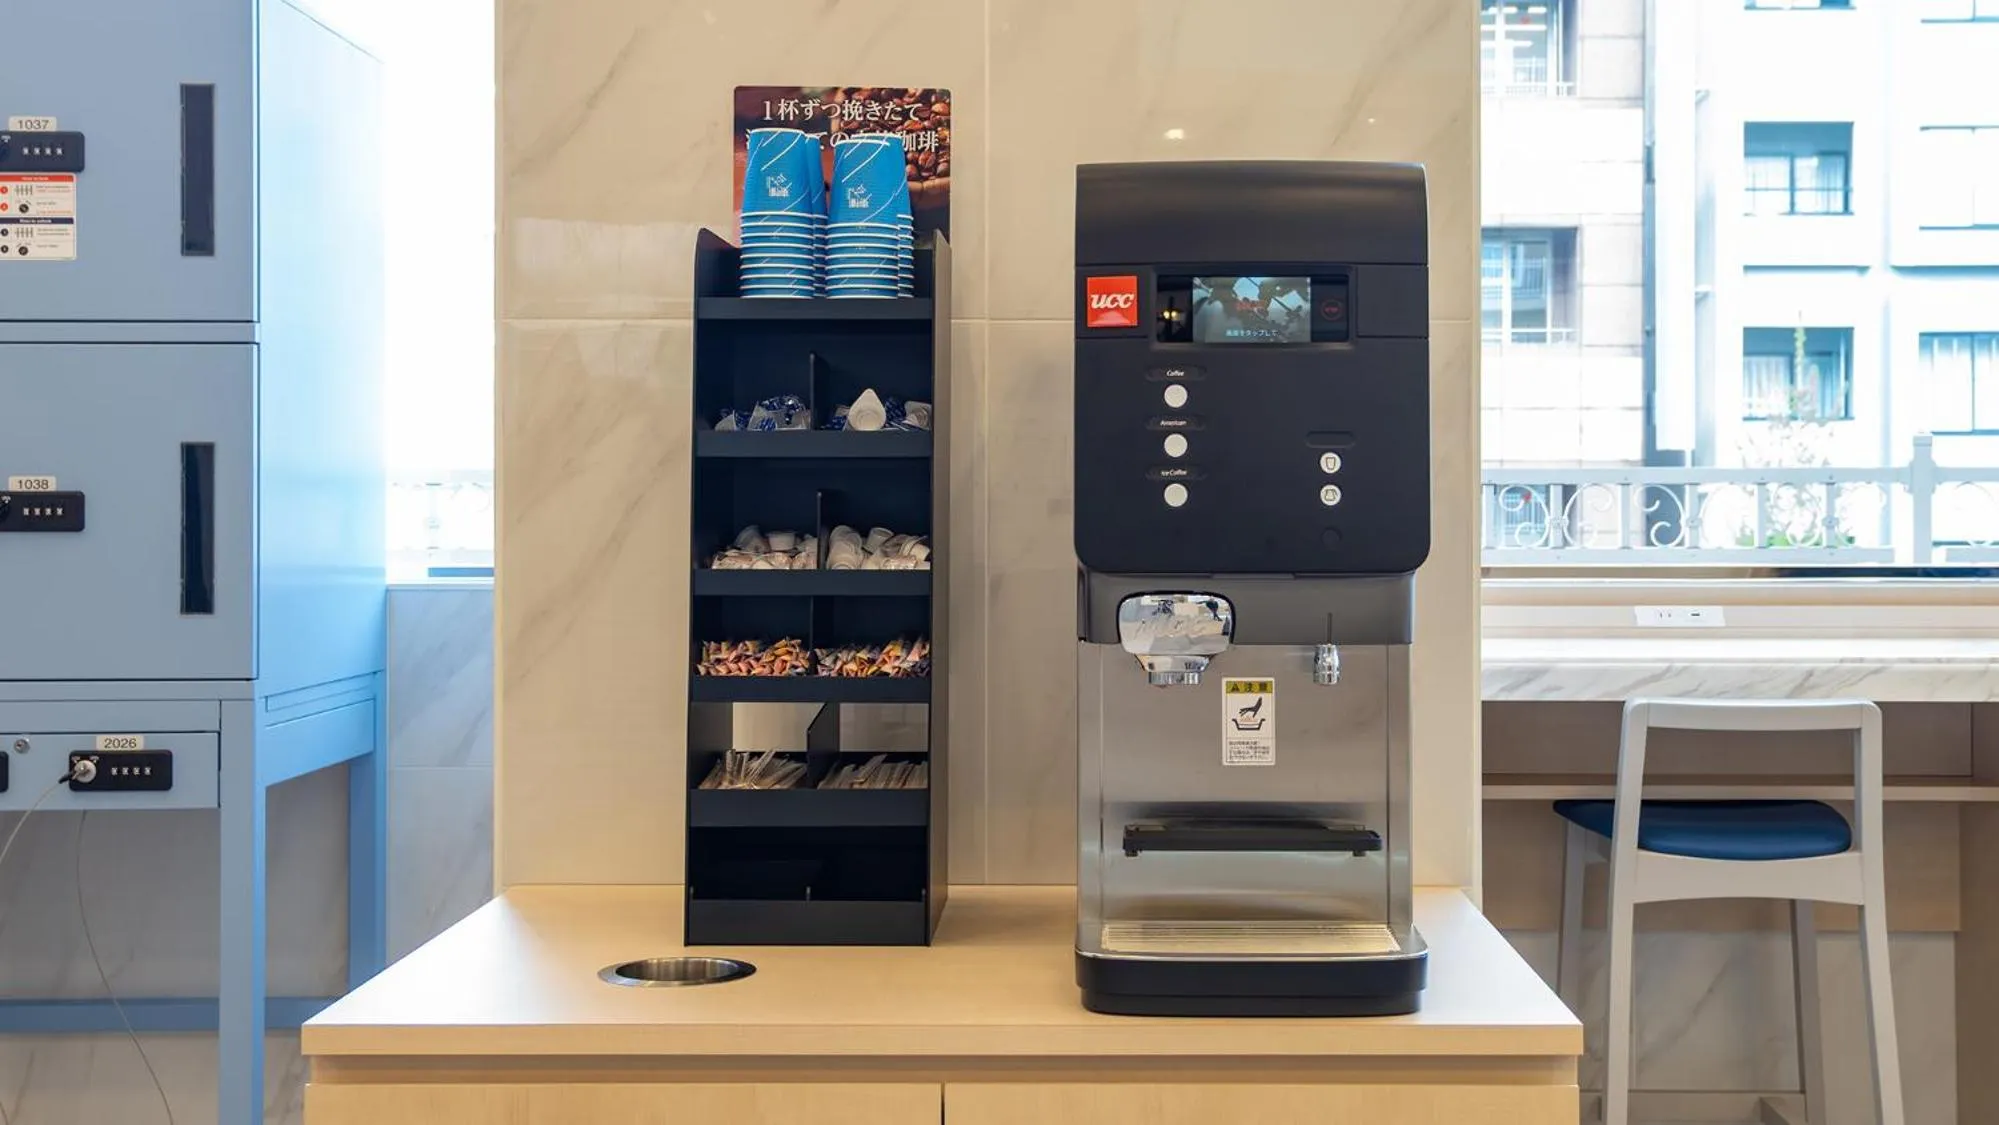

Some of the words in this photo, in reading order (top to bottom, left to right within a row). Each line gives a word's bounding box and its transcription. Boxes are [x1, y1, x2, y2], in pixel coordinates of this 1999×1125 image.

[763, 98, 924, 121] 1杯ずつ挽きたて
[18, 119, 49, 130] 1037
[18, 479, 49, 490] 1038
[104, 737, 137, 749] 2026
